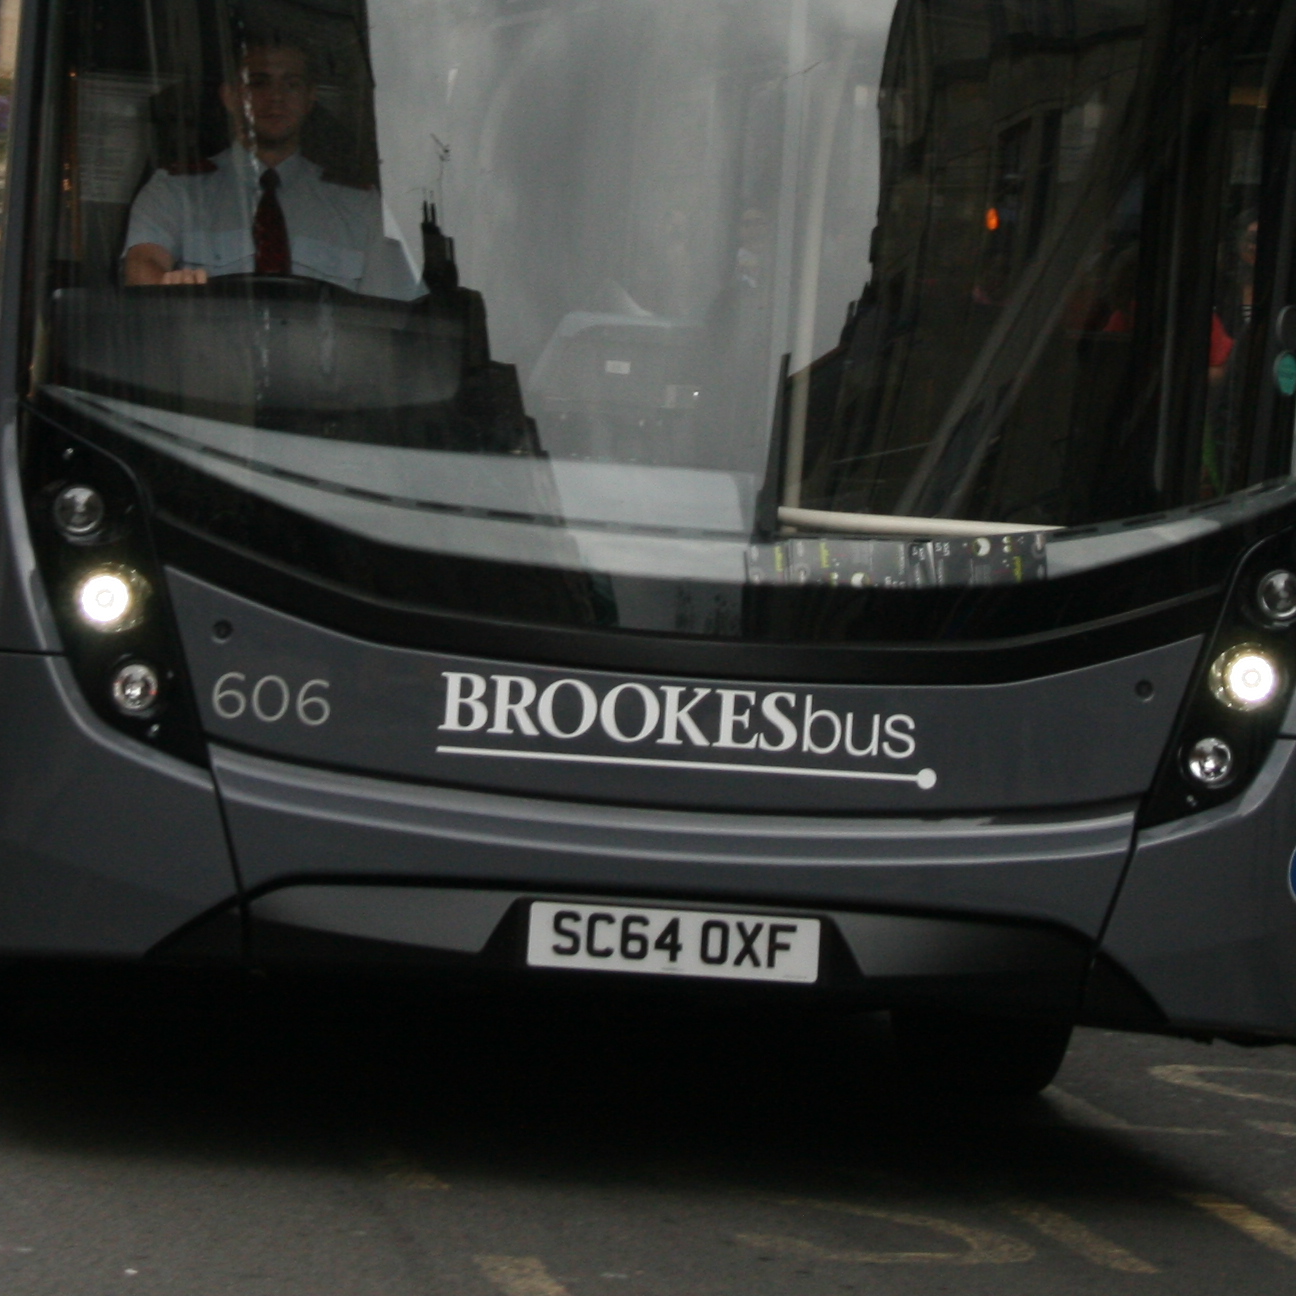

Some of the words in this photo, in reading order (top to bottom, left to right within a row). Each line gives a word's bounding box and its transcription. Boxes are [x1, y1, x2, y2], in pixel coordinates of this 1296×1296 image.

[211, 671, 331, 726] 606
[552, 910, 683, 964] SC64
[700, 920, 798, 970] OXF
